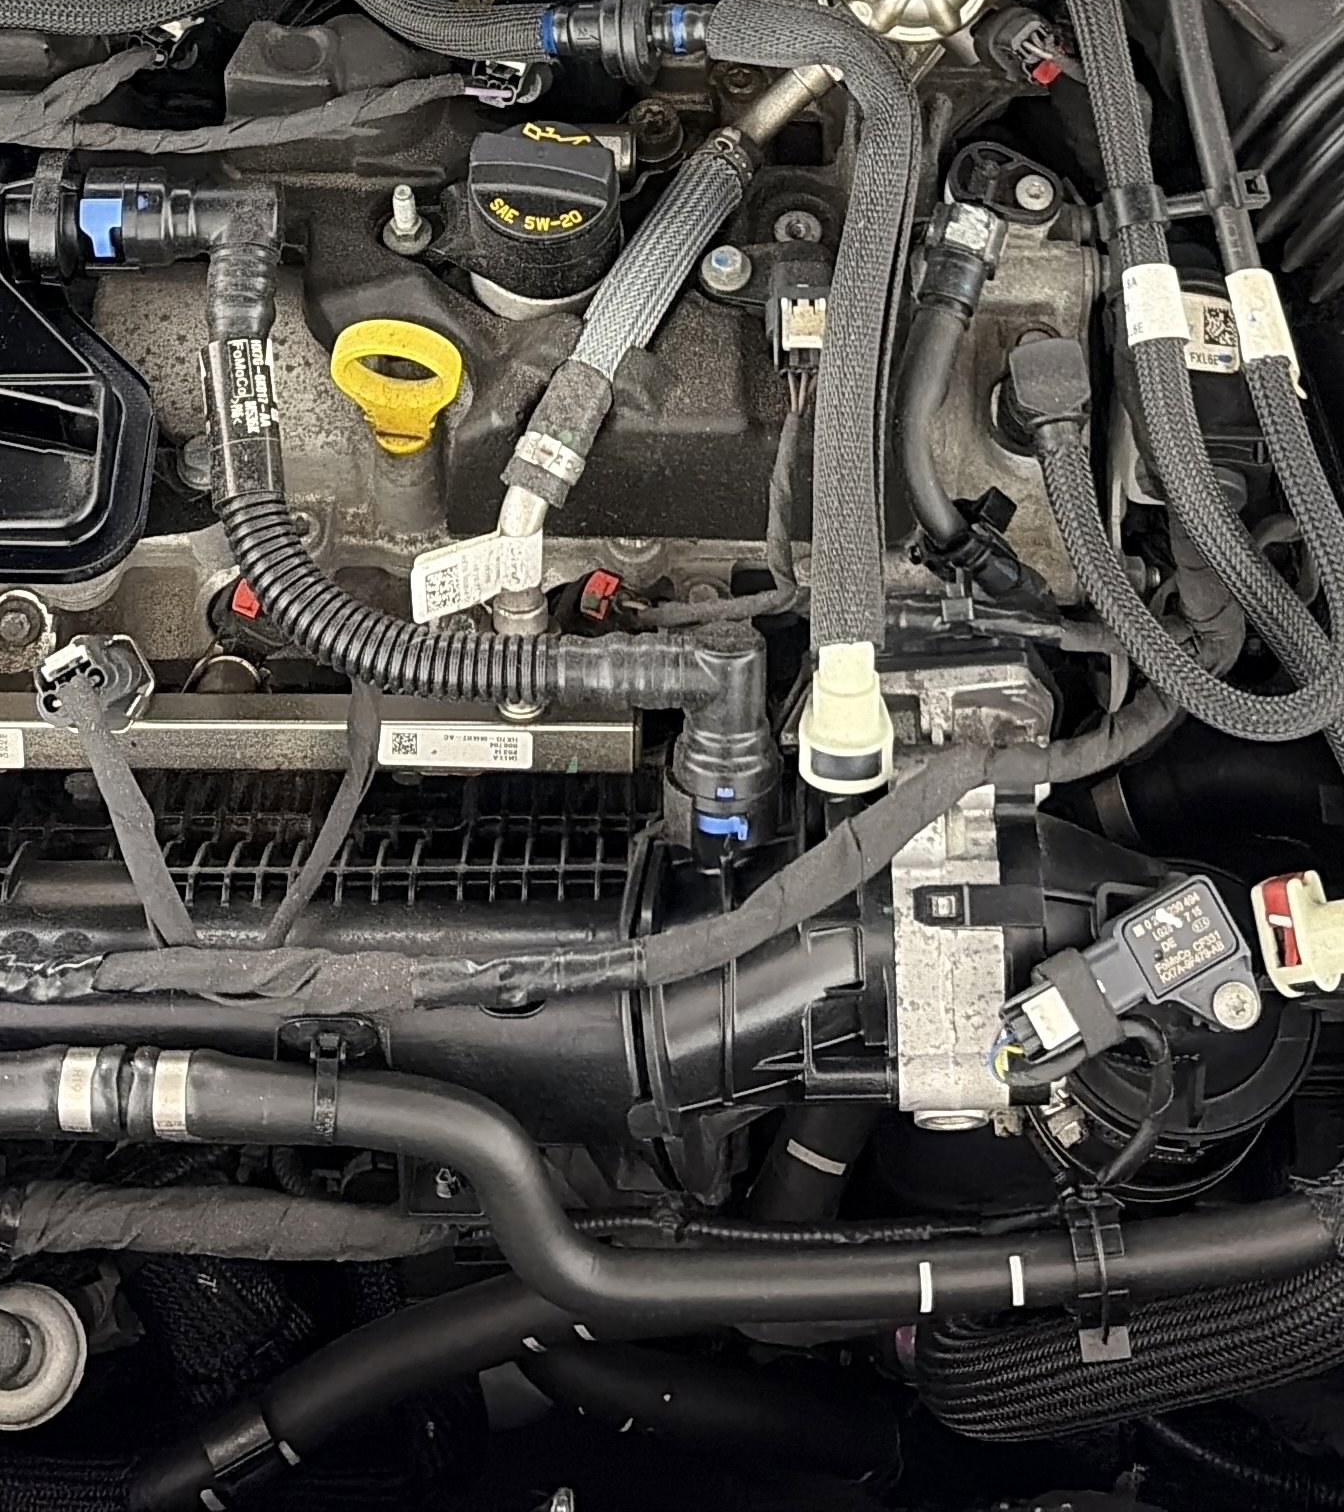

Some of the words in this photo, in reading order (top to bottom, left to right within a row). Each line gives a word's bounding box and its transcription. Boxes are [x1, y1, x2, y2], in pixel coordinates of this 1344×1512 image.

[489, 198, 519, 224] SAE
[524, 209, 582, 231] 5W-20
[232, 343, 248, 394] FoMoCo
[1155, 950, 1192, 973] FoMoCo
